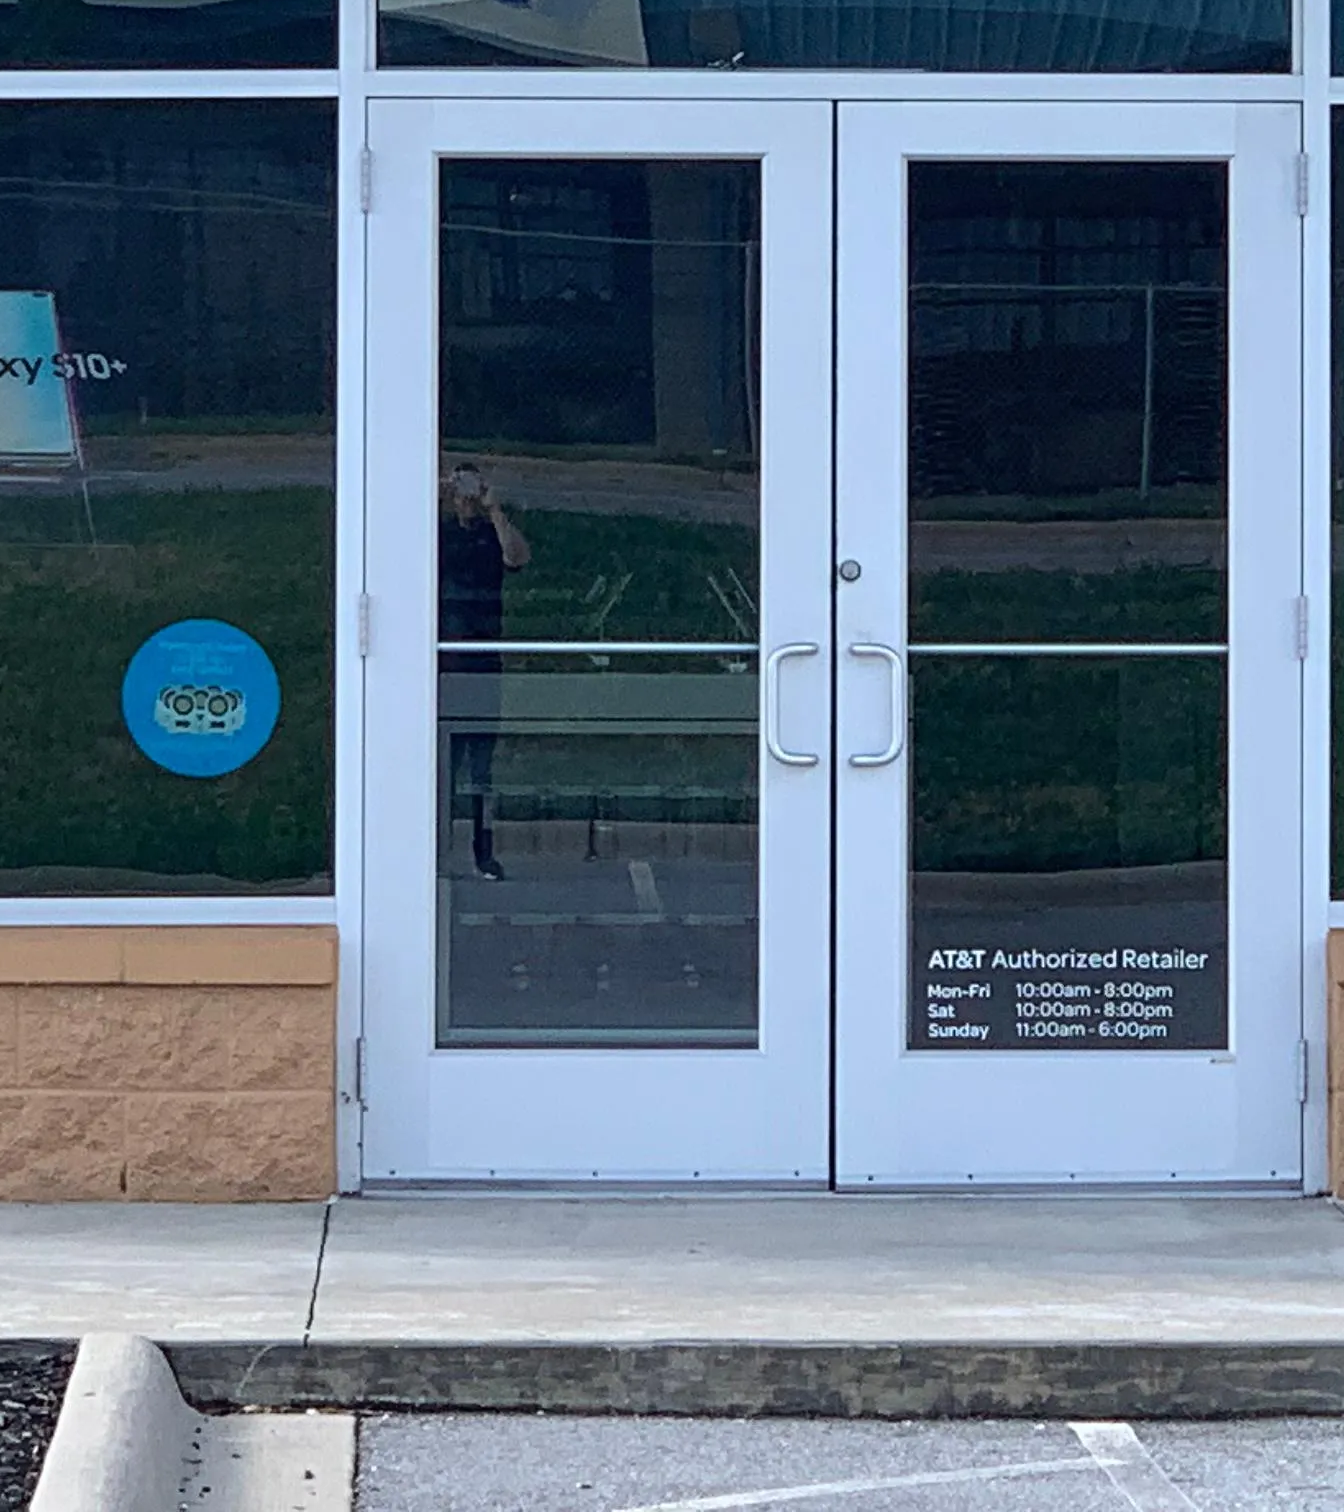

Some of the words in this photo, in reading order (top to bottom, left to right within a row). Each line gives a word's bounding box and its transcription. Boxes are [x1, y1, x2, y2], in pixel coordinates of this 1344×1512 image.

[51, 351, 128, 380] S10+
[927, 949, 986, 970] AT&T
[991, 948, 1118, 970] Authorized
[1122, 948, 1209, 970] Retailer
[927, 983, 991, 999] Mon-Fri
[1015, 982, 1091, 999] 10:00am
[927, 1003, 956, 1019] Sat
[1015, 1001, 1091, 1018] 10:00am
[927, 1022, 990, 1040] Sunday
[1015, 1021, 1086, 1038] 11:00am
[1098, 1021, 1168, 1040] 6:00pm
